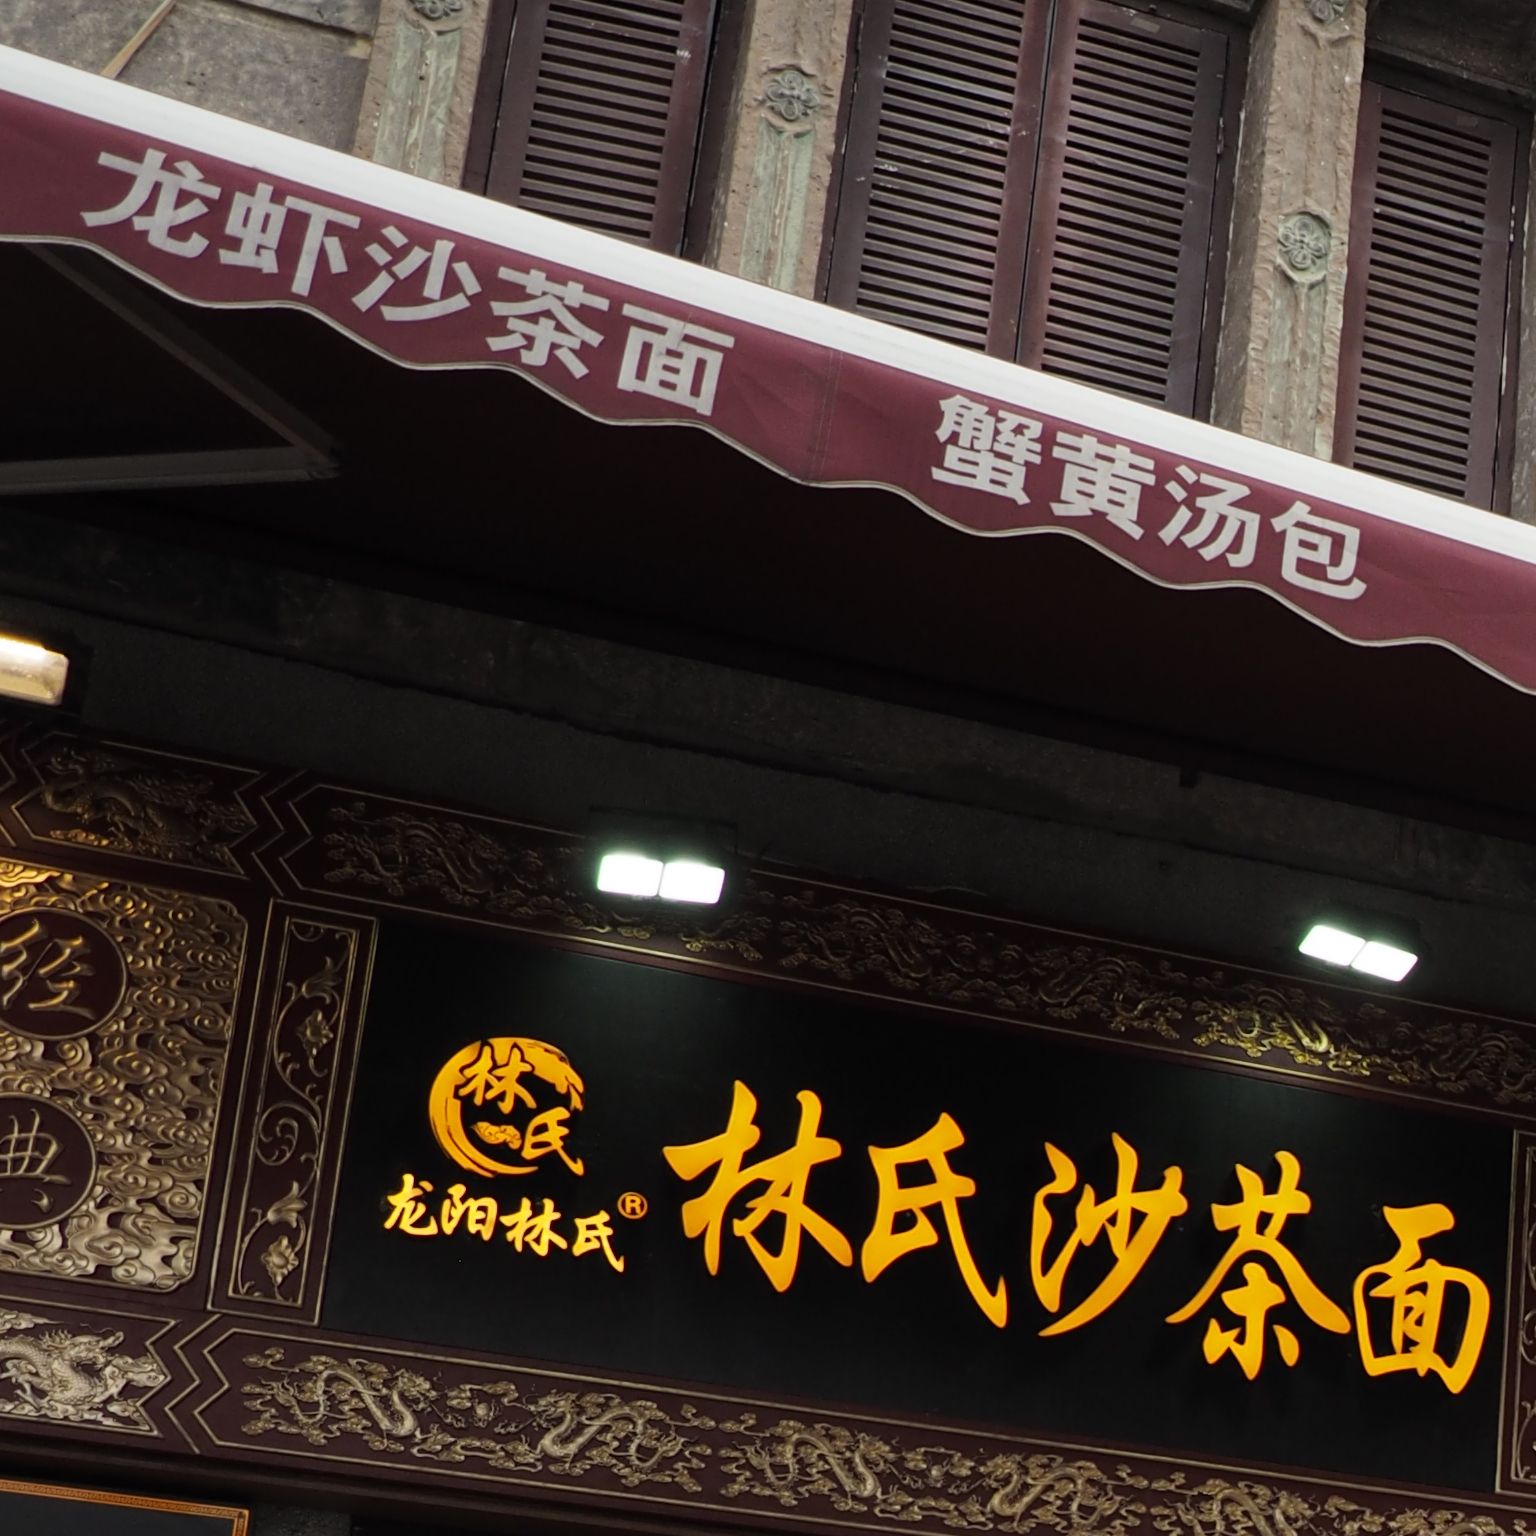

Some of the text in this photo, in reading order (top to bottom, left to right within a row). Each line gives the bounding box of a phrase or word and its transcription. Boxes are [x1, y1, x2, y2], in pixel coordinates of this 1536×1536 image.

[81, 148, 735, 416] 龙虾沙茶面
[931, 395, 1367, 600] 蟹黄汤包
[383, 1174, 626, 1273] 龙阳林氏
[662, 1080, 1491, 1394] 林氏沙茶面
